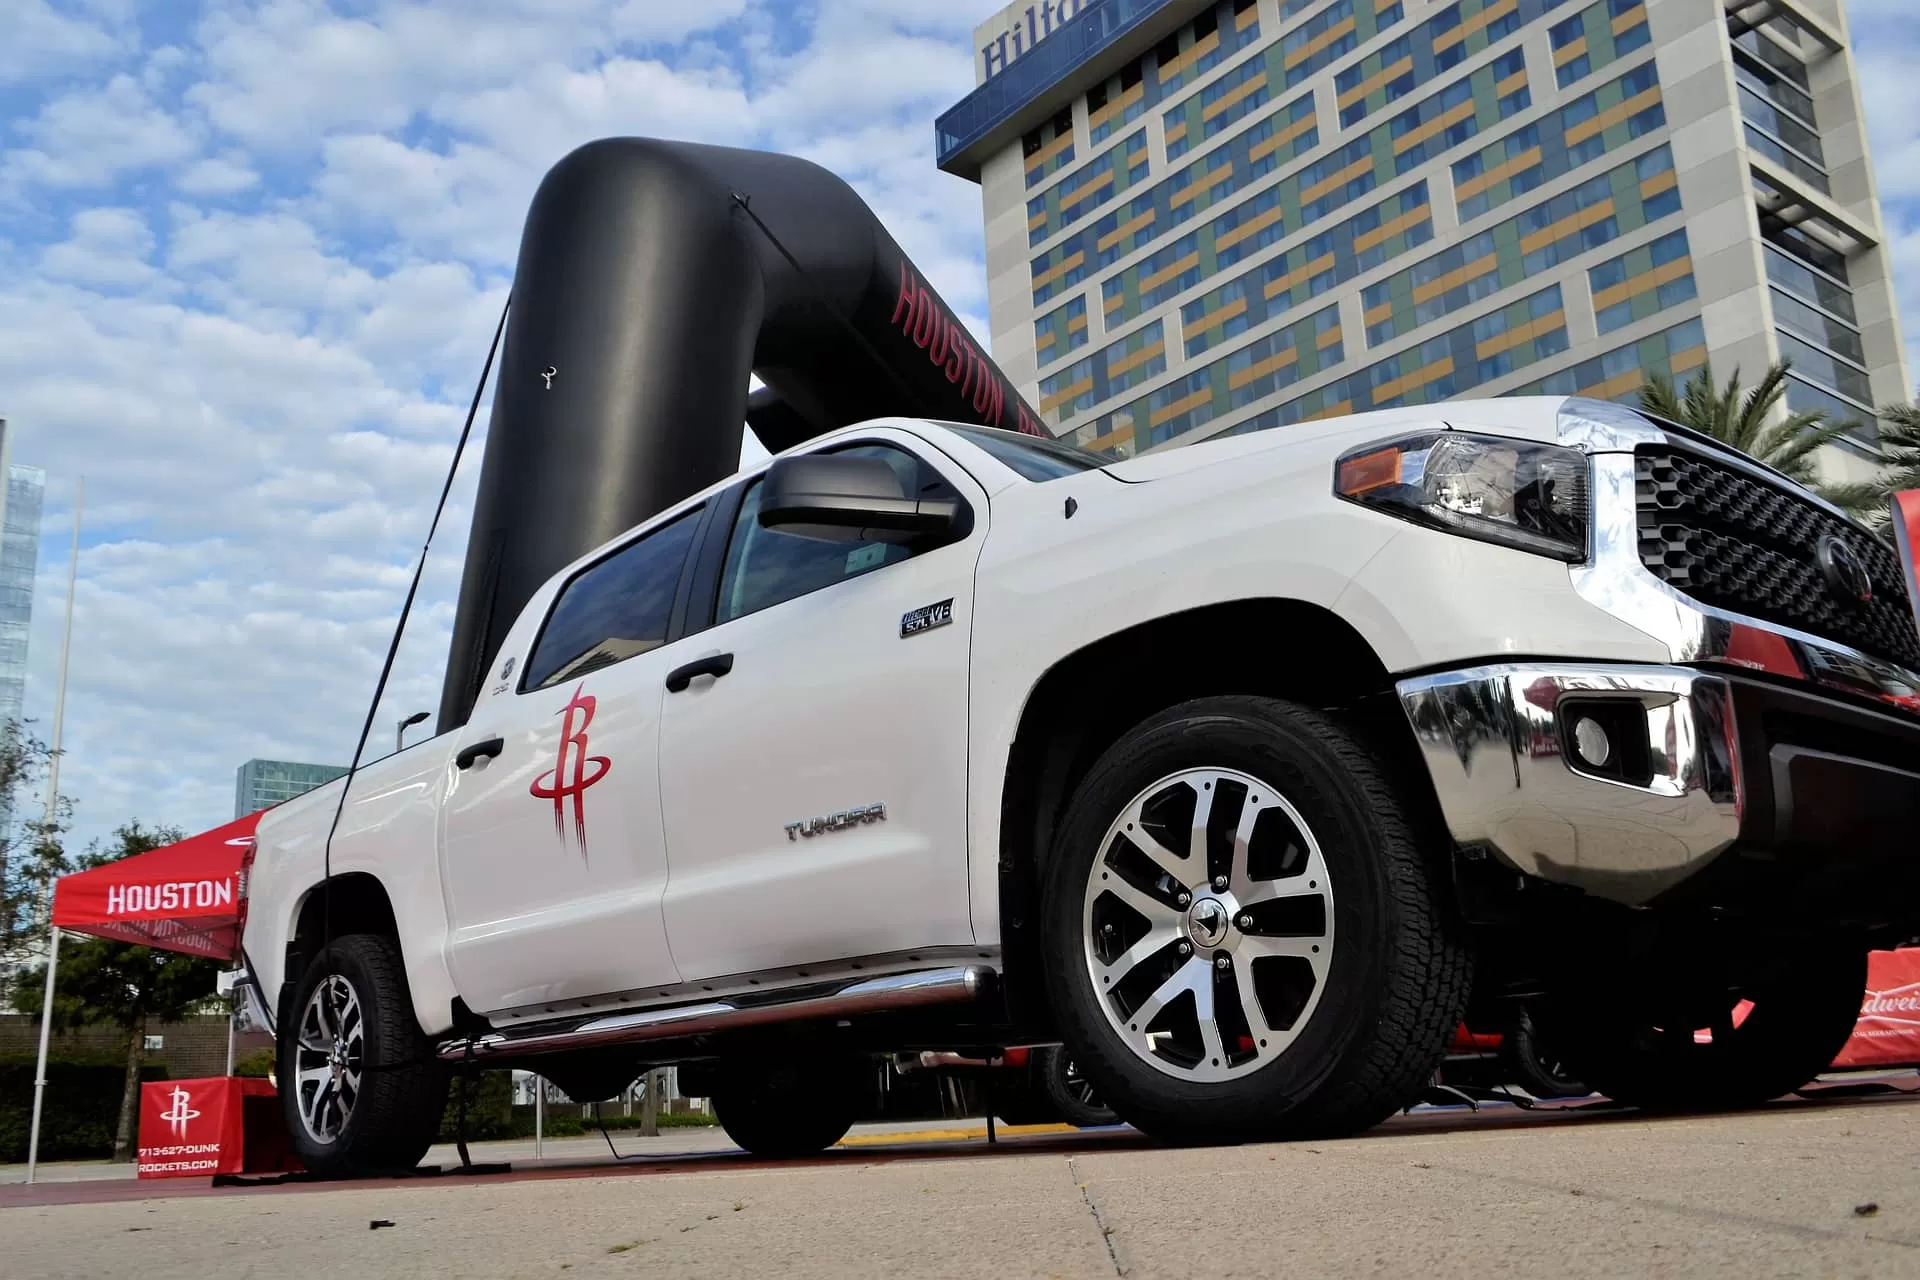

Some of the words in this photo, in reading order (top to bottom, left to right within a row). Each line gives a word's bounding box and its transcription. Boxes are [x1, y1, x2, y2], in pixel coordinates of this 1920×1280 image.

[982, 0, 1099, 81] Hilto
[891, 259, 1005, 426] HOUSTON
[931, 605, 950, 623] V8
[784, 801, 887, 841] TUNDRA
[107, 877, 231, 914] HOUSTON
[1860, 991, 1920, 1013] dwei
[138, 1144, 220, 1157] 713-627-DUNK
[138, 1160, 218, 1172] ROCKETS.COM
